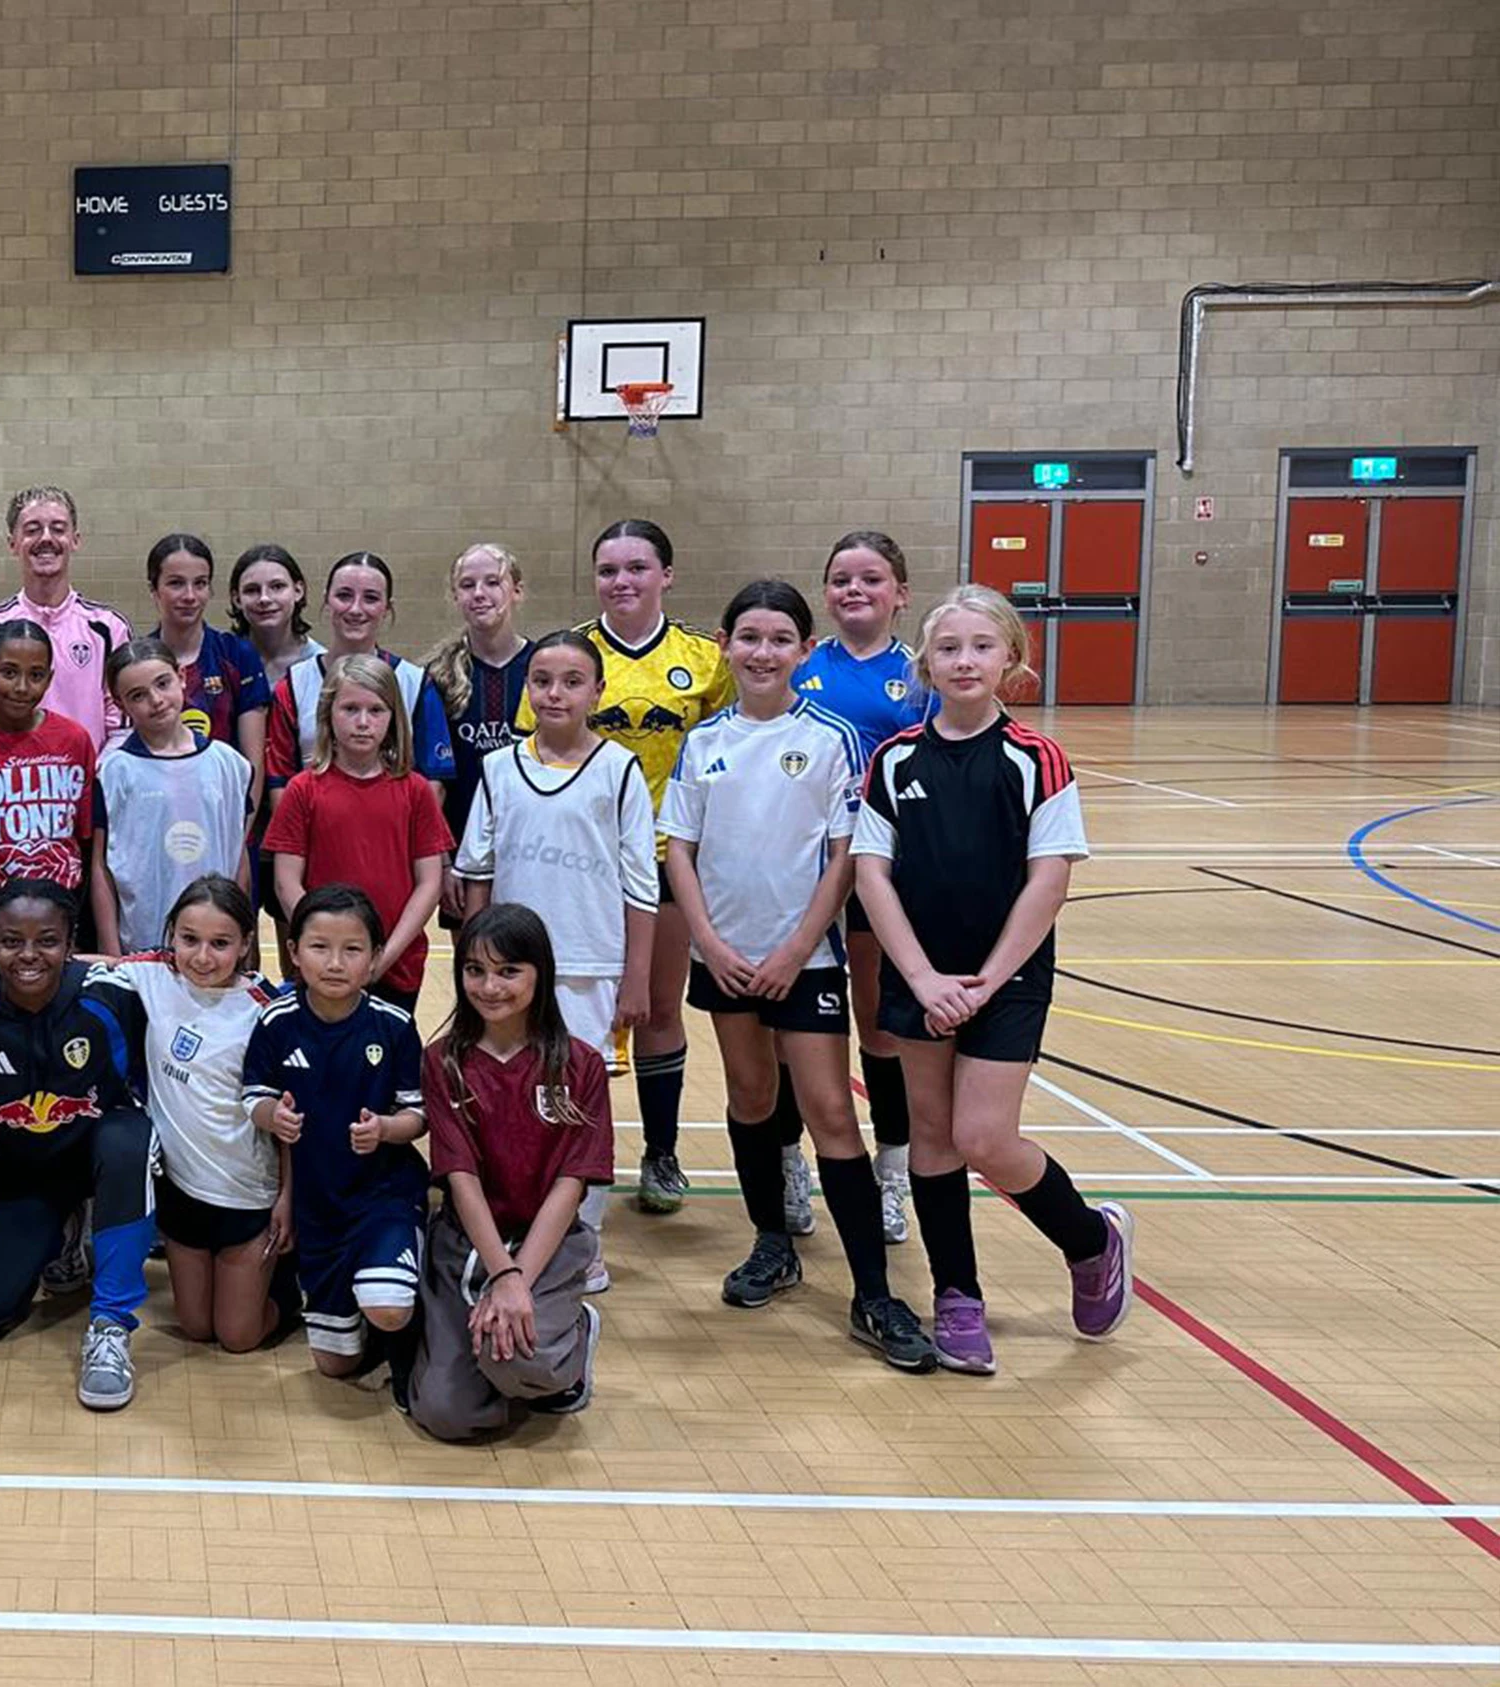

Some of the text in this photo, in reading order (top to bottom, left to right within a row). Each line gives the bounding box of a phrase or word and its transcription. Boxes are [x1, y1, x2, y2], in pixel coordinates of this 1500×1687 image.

[76, 193, 229, 214] HOME GUESTS
[111, 252, 193, 266] CONTINENTAL
[458, 721, 513, 743] QATA
